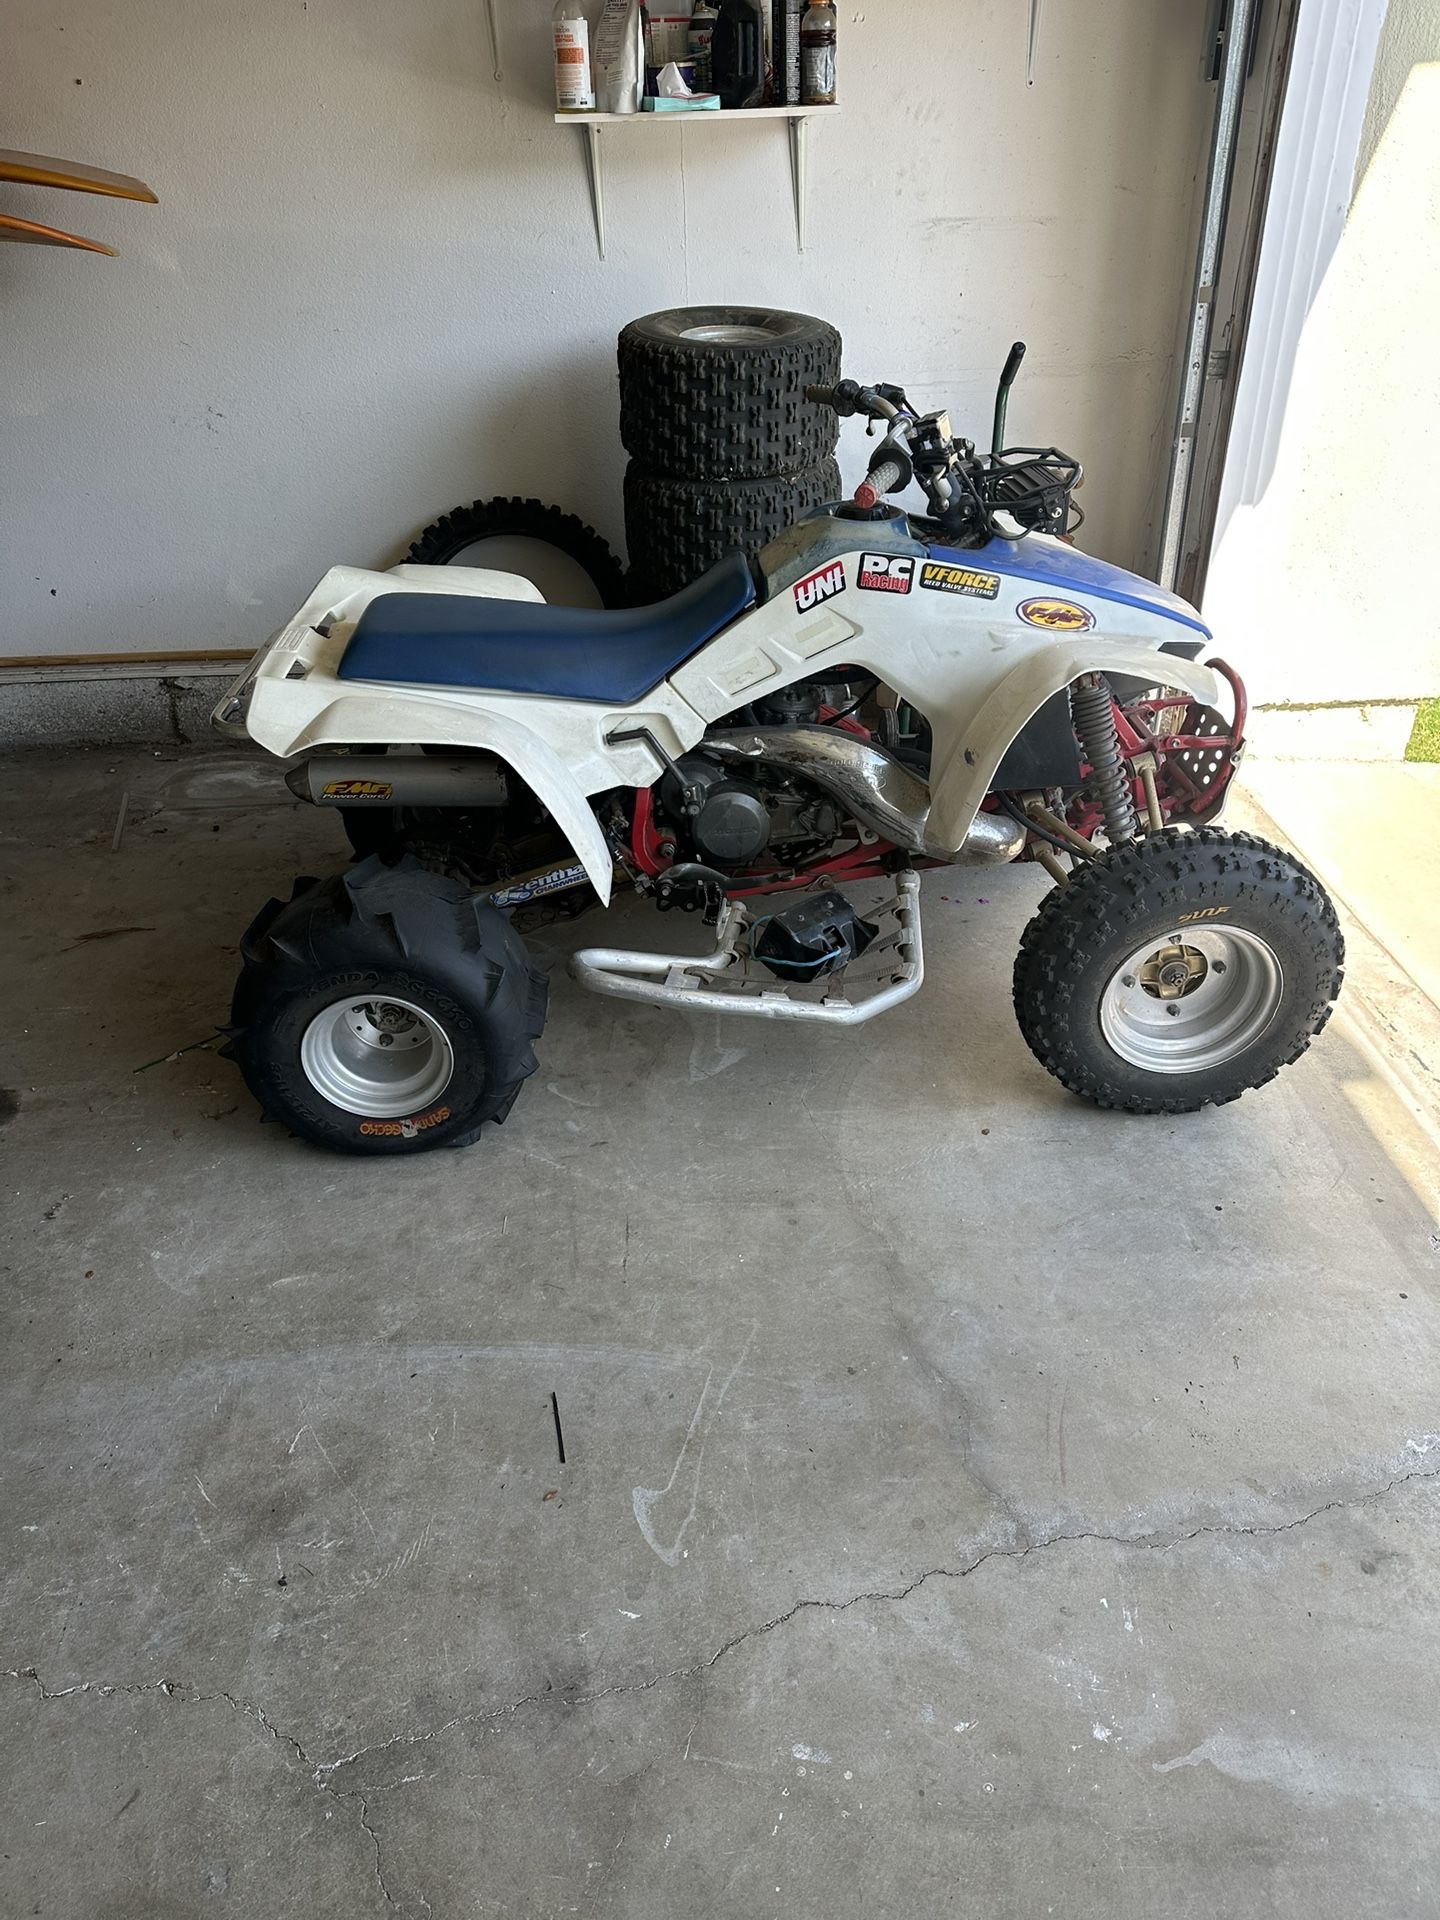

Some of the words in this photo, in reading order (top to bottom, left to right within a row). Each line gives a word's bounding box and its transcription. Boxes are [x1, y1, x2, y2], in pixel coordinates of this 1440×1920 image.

[863, 555, 912, 579] PC
[924, 565, 999, 590] VFORCE
[797, 566, 843, 609] UNI
[861, 571, 909, 593] Racing
[923, 579, 941, 587] REED
[941, 582, 962, 590] VALVE
[963, 585, 995, 596] SYSTEMS
[325, 782, 392, 794] FMF
[535, 874, 588, 895] CHAINWHEE
[360, 1122, 402, 1135] GECKO
[415, 1107, 450, 1129] SAND
